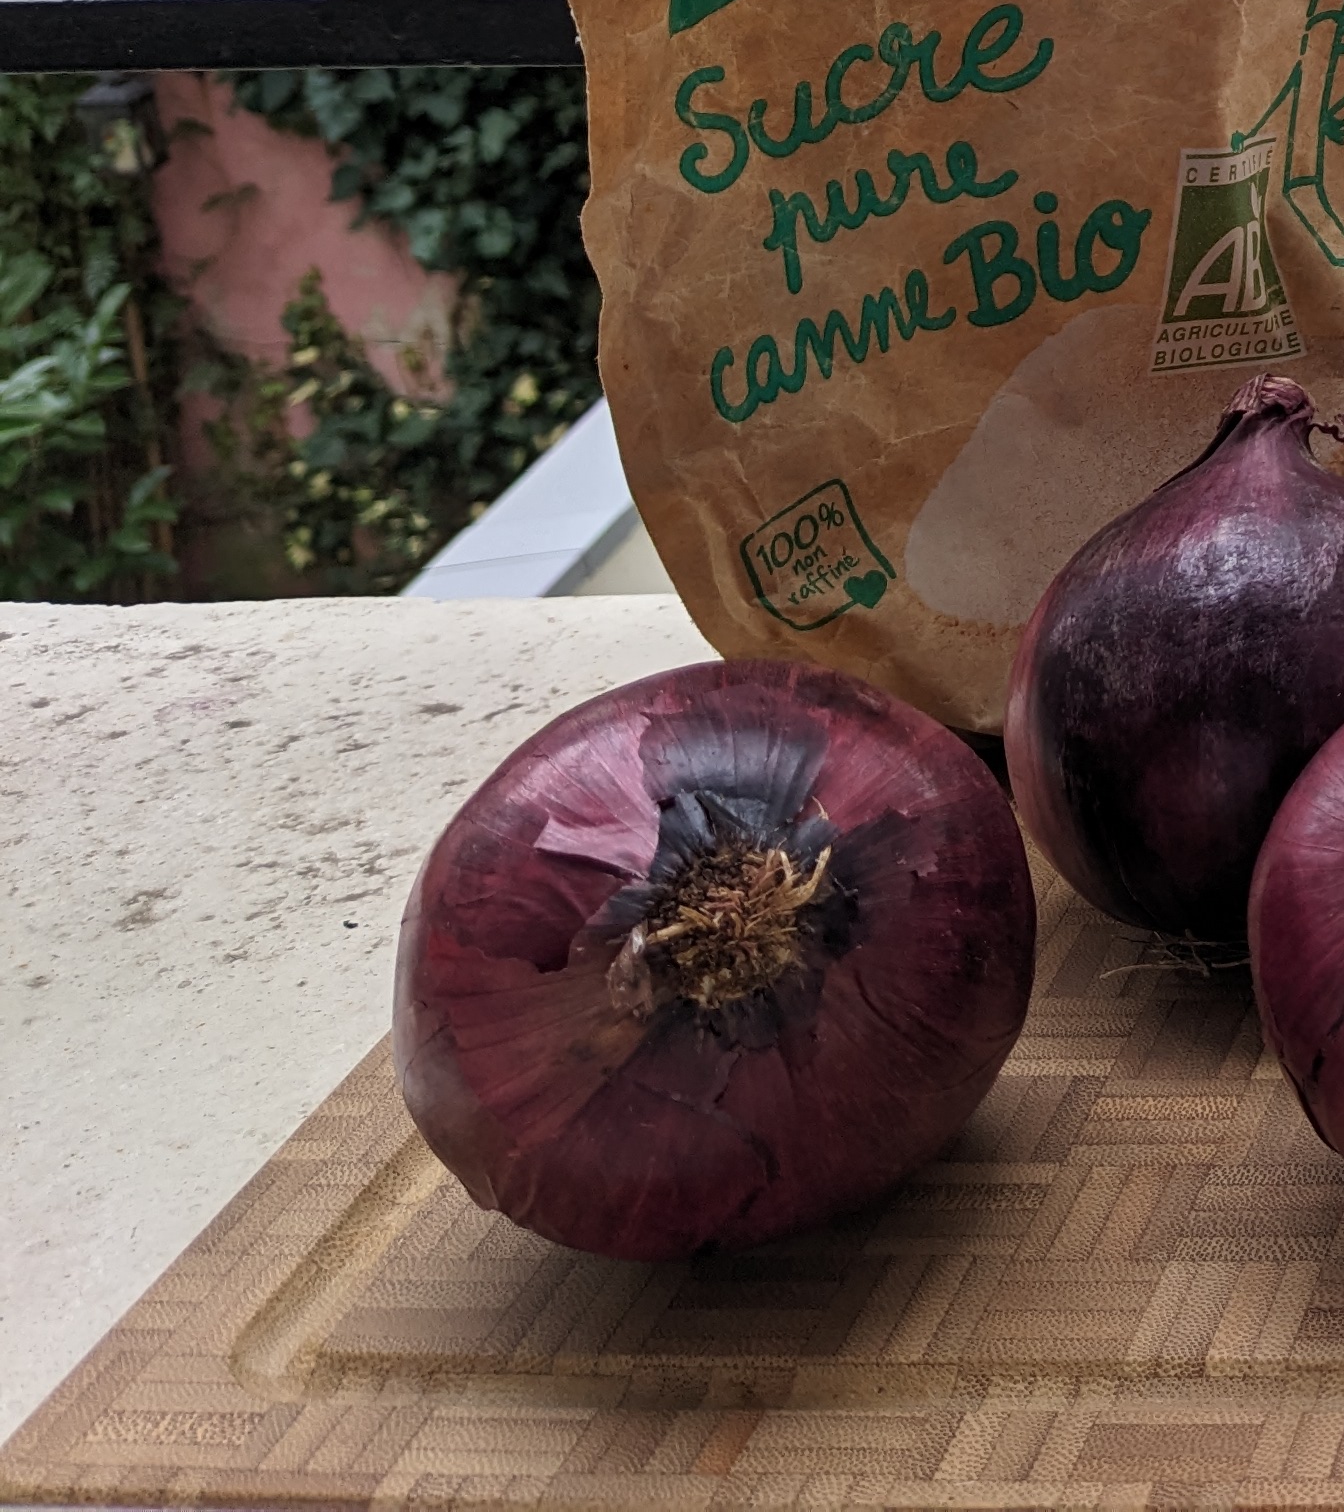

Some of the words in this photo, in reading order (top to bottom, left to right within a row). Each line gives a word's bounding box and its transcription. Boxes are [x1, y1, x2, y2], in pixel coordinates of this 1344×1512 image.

[675, 3, 1054, 194] Sucre
[763, 140, 1019, 294] pure
[1172, 220, 1267, 317] AB
[709, 269, 958, 423] canne
[943, 190, 1153, 328] Bio
[1157, 309, 1295, 344] AGRICULTURE
[1154, 331, 1302, 366] BIOLOGIQUE
[756, 501, 845, 576] 100%
[787, 546, 860, 605] raffiné
[792, 545, 828, 576] non
